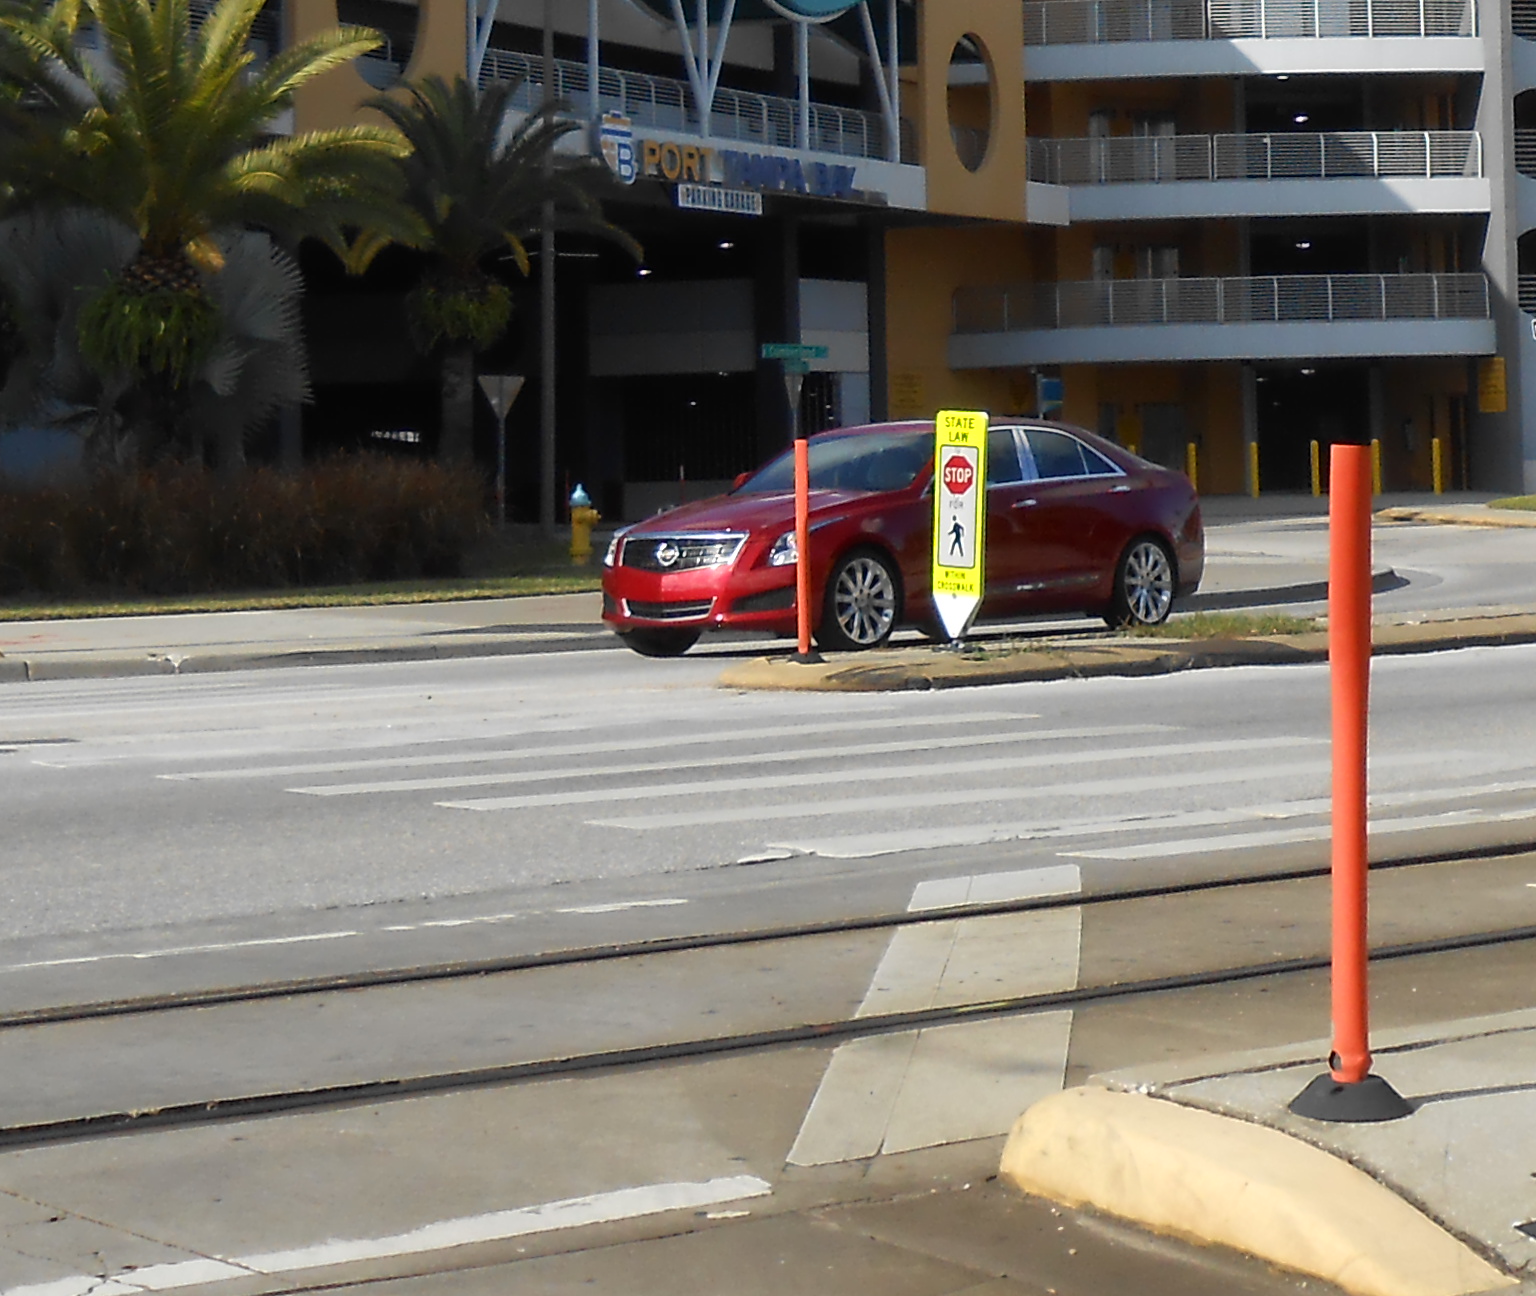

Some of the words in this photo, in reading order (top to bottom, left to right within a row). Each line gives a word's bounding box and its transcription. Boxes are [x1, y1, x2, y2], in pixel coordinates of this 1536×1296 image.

[642, 138, 715, 183] PORT
[721, 148, 810, 194] TAMPA
[683, 187, 722, 209] PARKING
[723, 191, 756, 212] GARAGE
[944, 417, 975, 429] STATE
[948, 431, 970, 443] LAW
[944, 466, 973, 483] STOP
[948, 499, 964, 509] FOR
[944, 570, 966, 580] WITHIN
[937, 580, 974, 593] CROSSWALK
